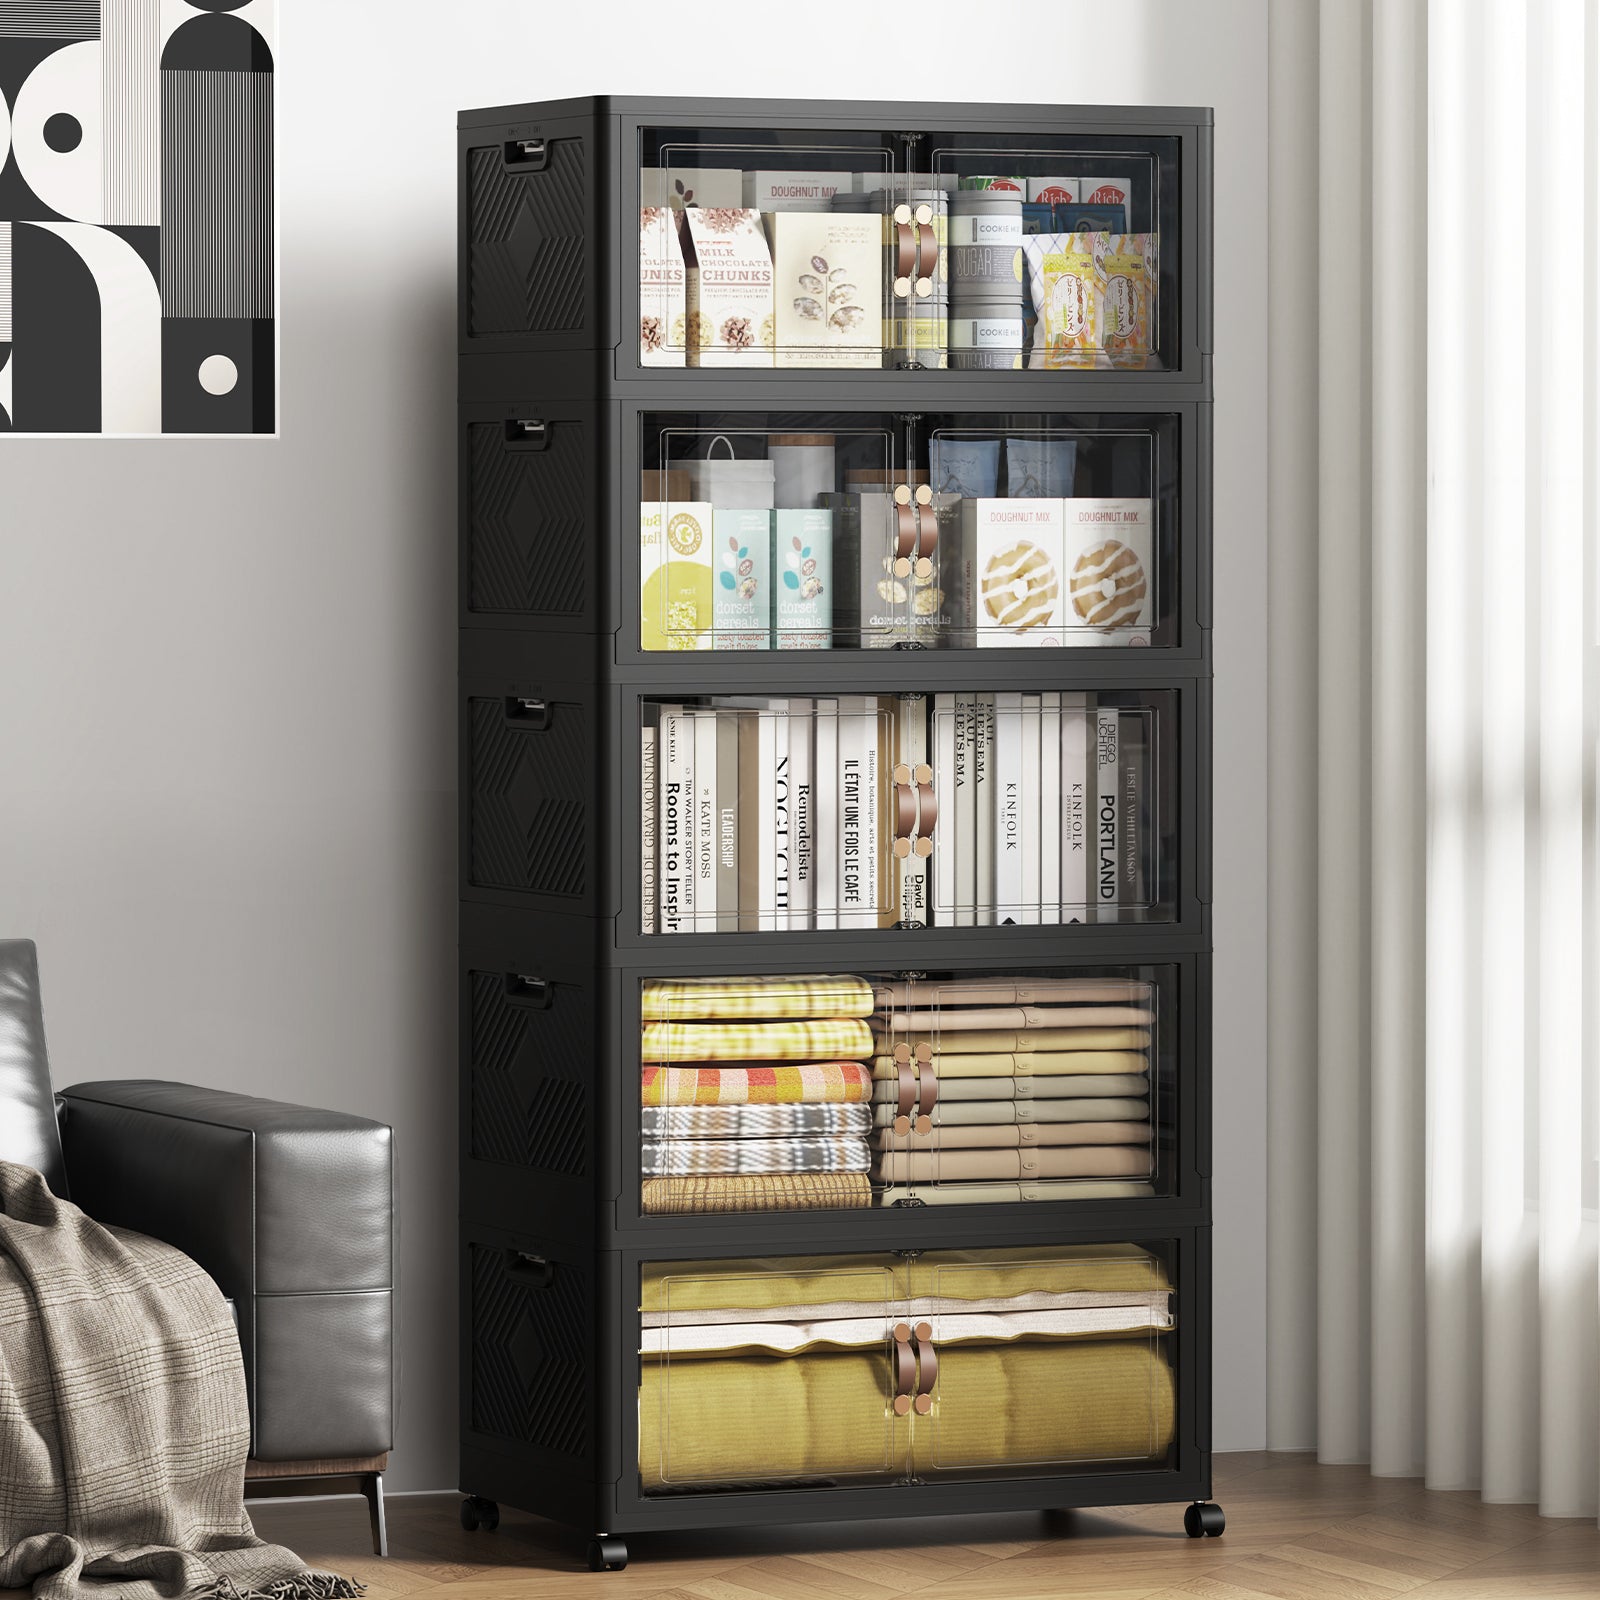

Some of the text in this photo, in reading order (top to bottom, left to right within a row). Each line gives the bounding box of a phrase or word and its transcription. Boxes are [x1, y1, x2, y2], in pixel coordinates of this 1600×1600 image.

[771, 186, 818, 198] DOUGHNUT
[698, 248, 735, 257] MILK
[957, 247, 992, 277] SUGAR
[702, 270, 771, 281] CHUNKS
[990, 512, 1051, 522] DOUGHNUT MIX
[1079, 511, 1138, 522] DOUGHNUT MIX
[717, 601, 754, 614] dorset
[780, 601, 817, 614] dorset
[956, 702, 965, 787] SIETSEMA
[967, 703, 975, 746] PAUL
[1099, 717, 1108, 770] UCHITEL
[1107, 724, 1116, 763] DIEGO
[1127, 767, 1136, 801] LESLIE
[643, 742, 655, 928] SECRETO DE GRAY MOUNTAIN
[722, 809, 734, 867] LEADERSHIP
[798, 784, 813, 880] Remodelista
[845, 760, 861, 902] IL ÉTAIT UNE FOIS LE CAFÉ
[1007, 783, 1017, 850] KINFOLK
[1073, 783, 1082, 851] KINFOLK
[663, 783, 681, 932] Rooms to Inspir
[701, 801, 711, 879] KATE MOSS
[1101, 795, 1115, 899] PORTLAND
[915, 874, 924, 908] David
